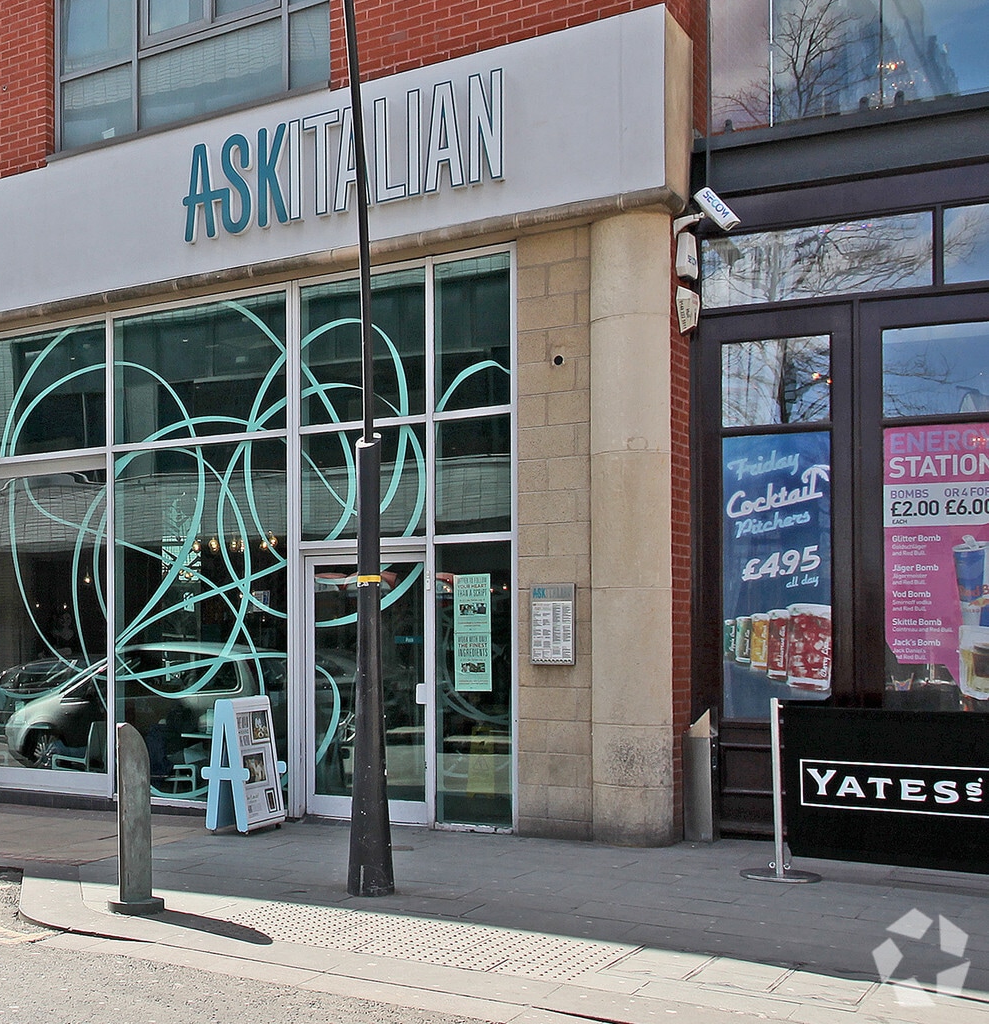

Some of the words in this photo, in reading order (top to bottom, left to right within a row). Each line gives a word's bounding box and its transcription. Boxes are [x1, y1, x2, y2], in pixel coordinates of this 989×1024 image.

[702, 190, 730, 218] SECOM
[726, 449, 800, 481] Friday
[726, 464, 830, 518] Cocktail
[890, 488, 929, 500] BOMBS
[944, 487, 960, 497] OR
[961, 487, 968, 497] 4
[890, 499, 940, 517] £2.00
[735, 511, 811, 539] Pitchers
[892, 535, 917, 543] Glitter
[918, 534, 942, 542] Bomb
[892, 564, 915, 573] Jäger
[916, 563, 939, 571] Bomb
[785, 575, 799, 589] all
[801, 574, 820, 587] day
[892, 590, 906, 598] Vod
[908, 590, 931, 598] Bomb
[918, 618, 942, 626] Bomb
[892, 638, 917, 646] Jack's
[917, 638, 941, 646] Bomb
